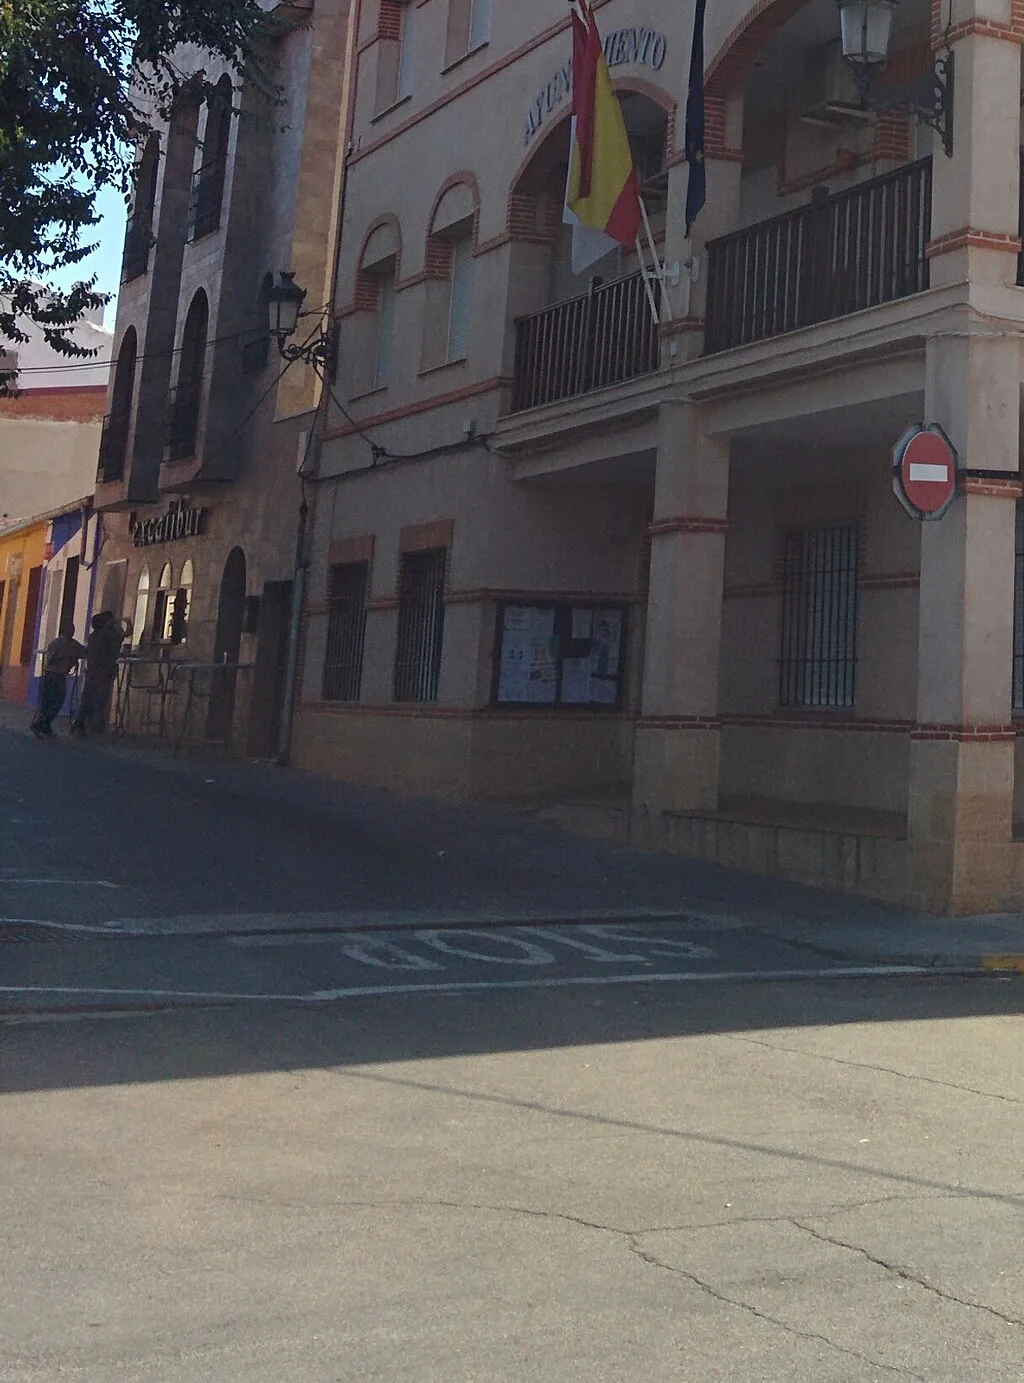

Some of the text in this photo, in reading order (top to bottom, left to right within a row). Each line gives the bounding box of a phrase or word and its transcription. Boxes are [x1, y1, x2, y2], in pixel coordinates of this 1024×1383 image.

[521, 27, 666, 145] AYUNIENTO
[132, 496, 203, 546] excalibur
[338, 924, 719, 971] STOP
